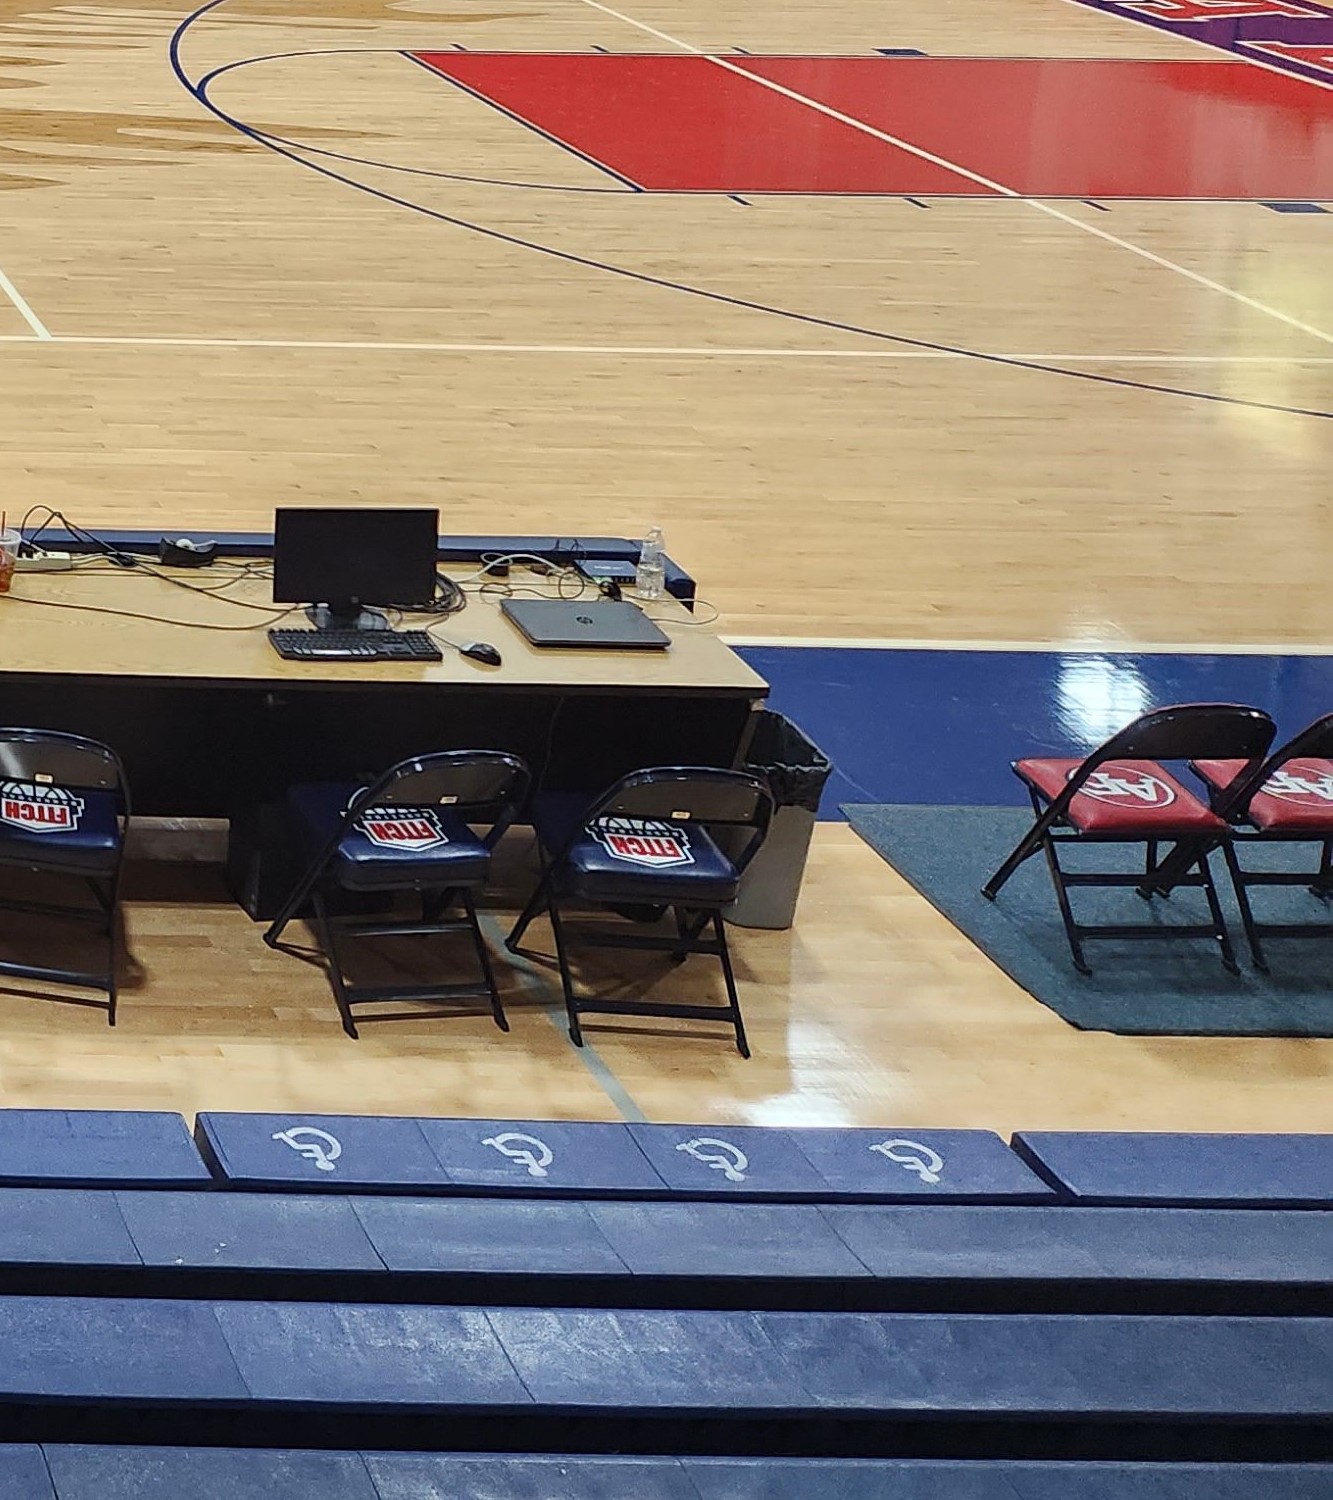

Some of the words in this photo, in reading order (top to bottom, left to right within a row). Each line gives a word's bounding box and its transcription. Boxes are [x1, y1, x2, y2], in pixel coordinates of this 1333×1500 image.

[5, 800, 68, 825] FITCH
[368, 820, 438, 841] FITCH
[607, 835, 681, 856] FITCH
